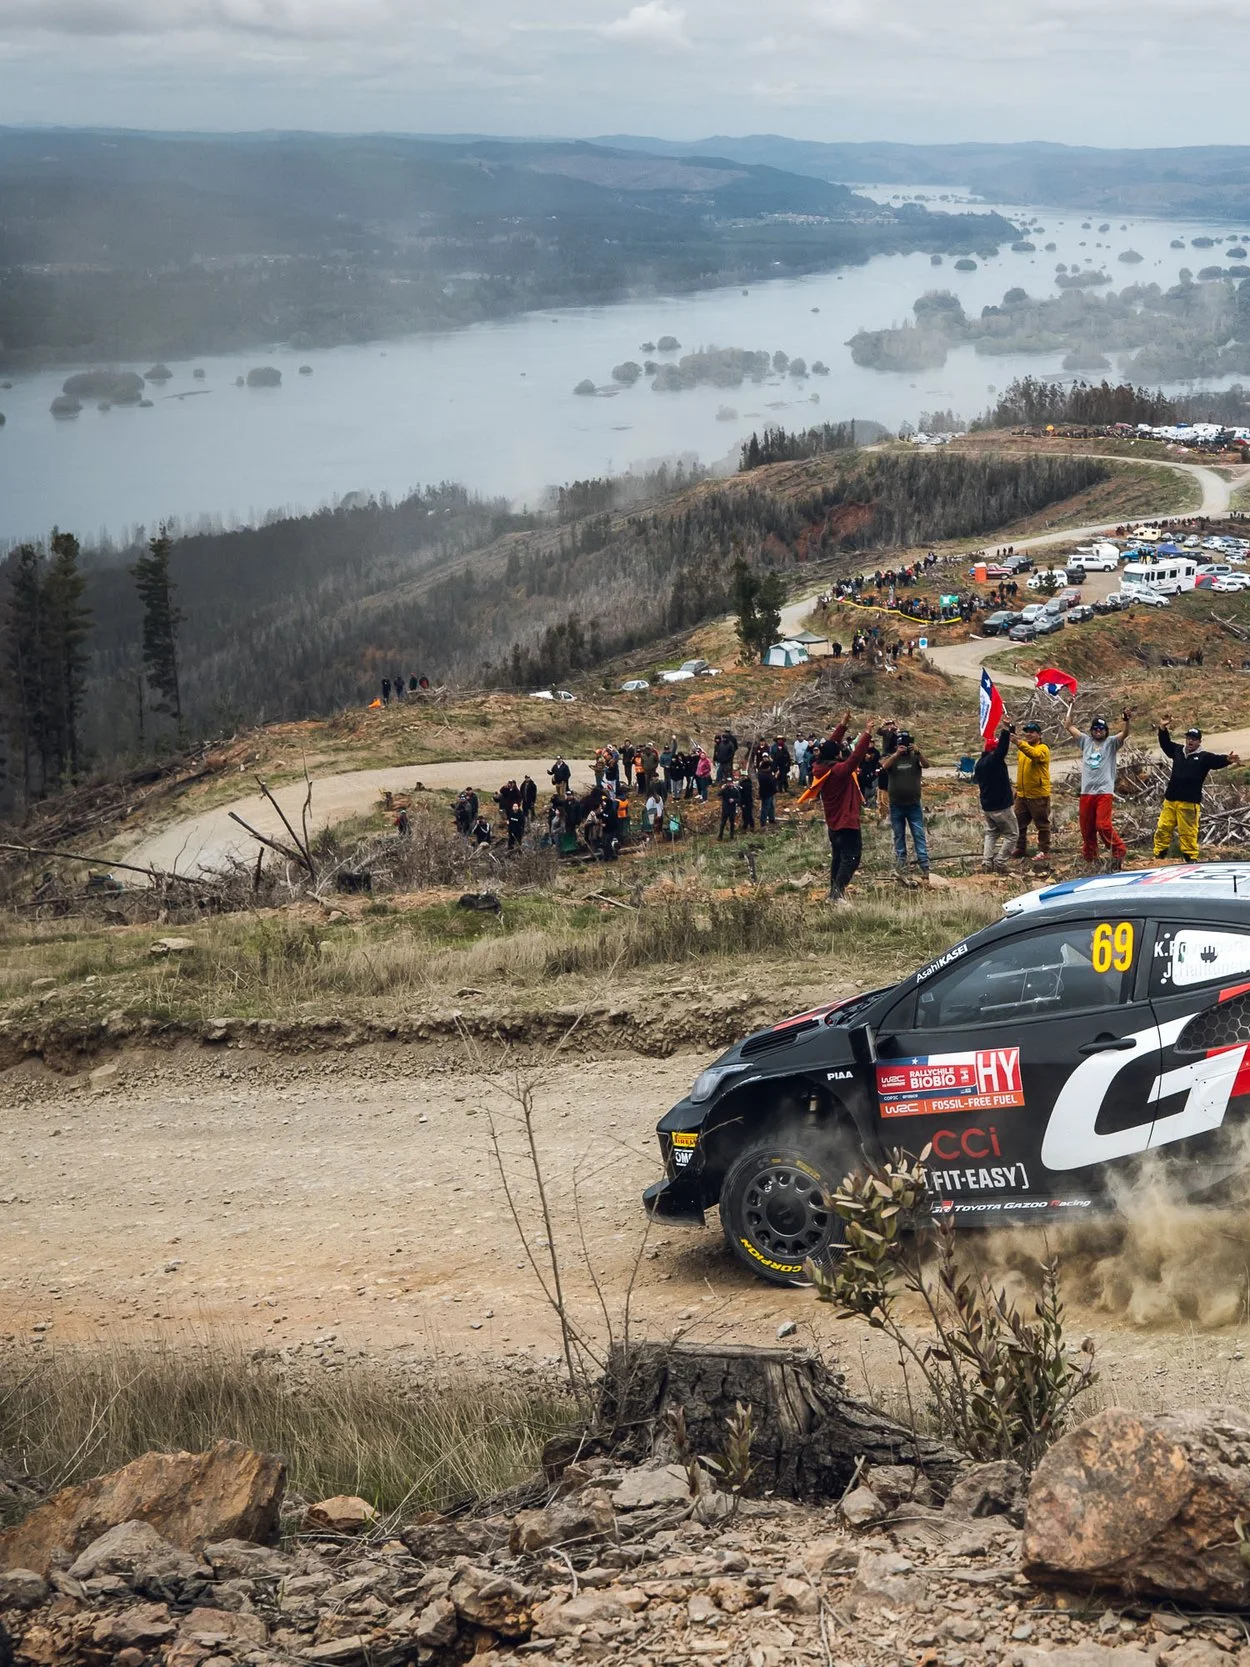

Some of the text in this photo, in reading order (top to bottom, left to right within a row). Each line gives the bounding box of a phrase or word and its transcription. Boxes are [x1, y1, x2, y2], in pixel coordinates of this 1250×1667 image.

[1092, 921, 1134, 973] 69
[827, 1070, 853, 1081] PIAA
[976, 1050, 1018, 1093] HY
[885, 1095, 1018, 1114] WRC FOSSIL-FREE FUEL
[954, 1203, 1001, 1212] TOYOTA
[1003, 1201, 1049, 1210] GAZOO
[1050, 1199, 1092, 1208] Racing
[740, 1238, 802, 1273] CORPION
